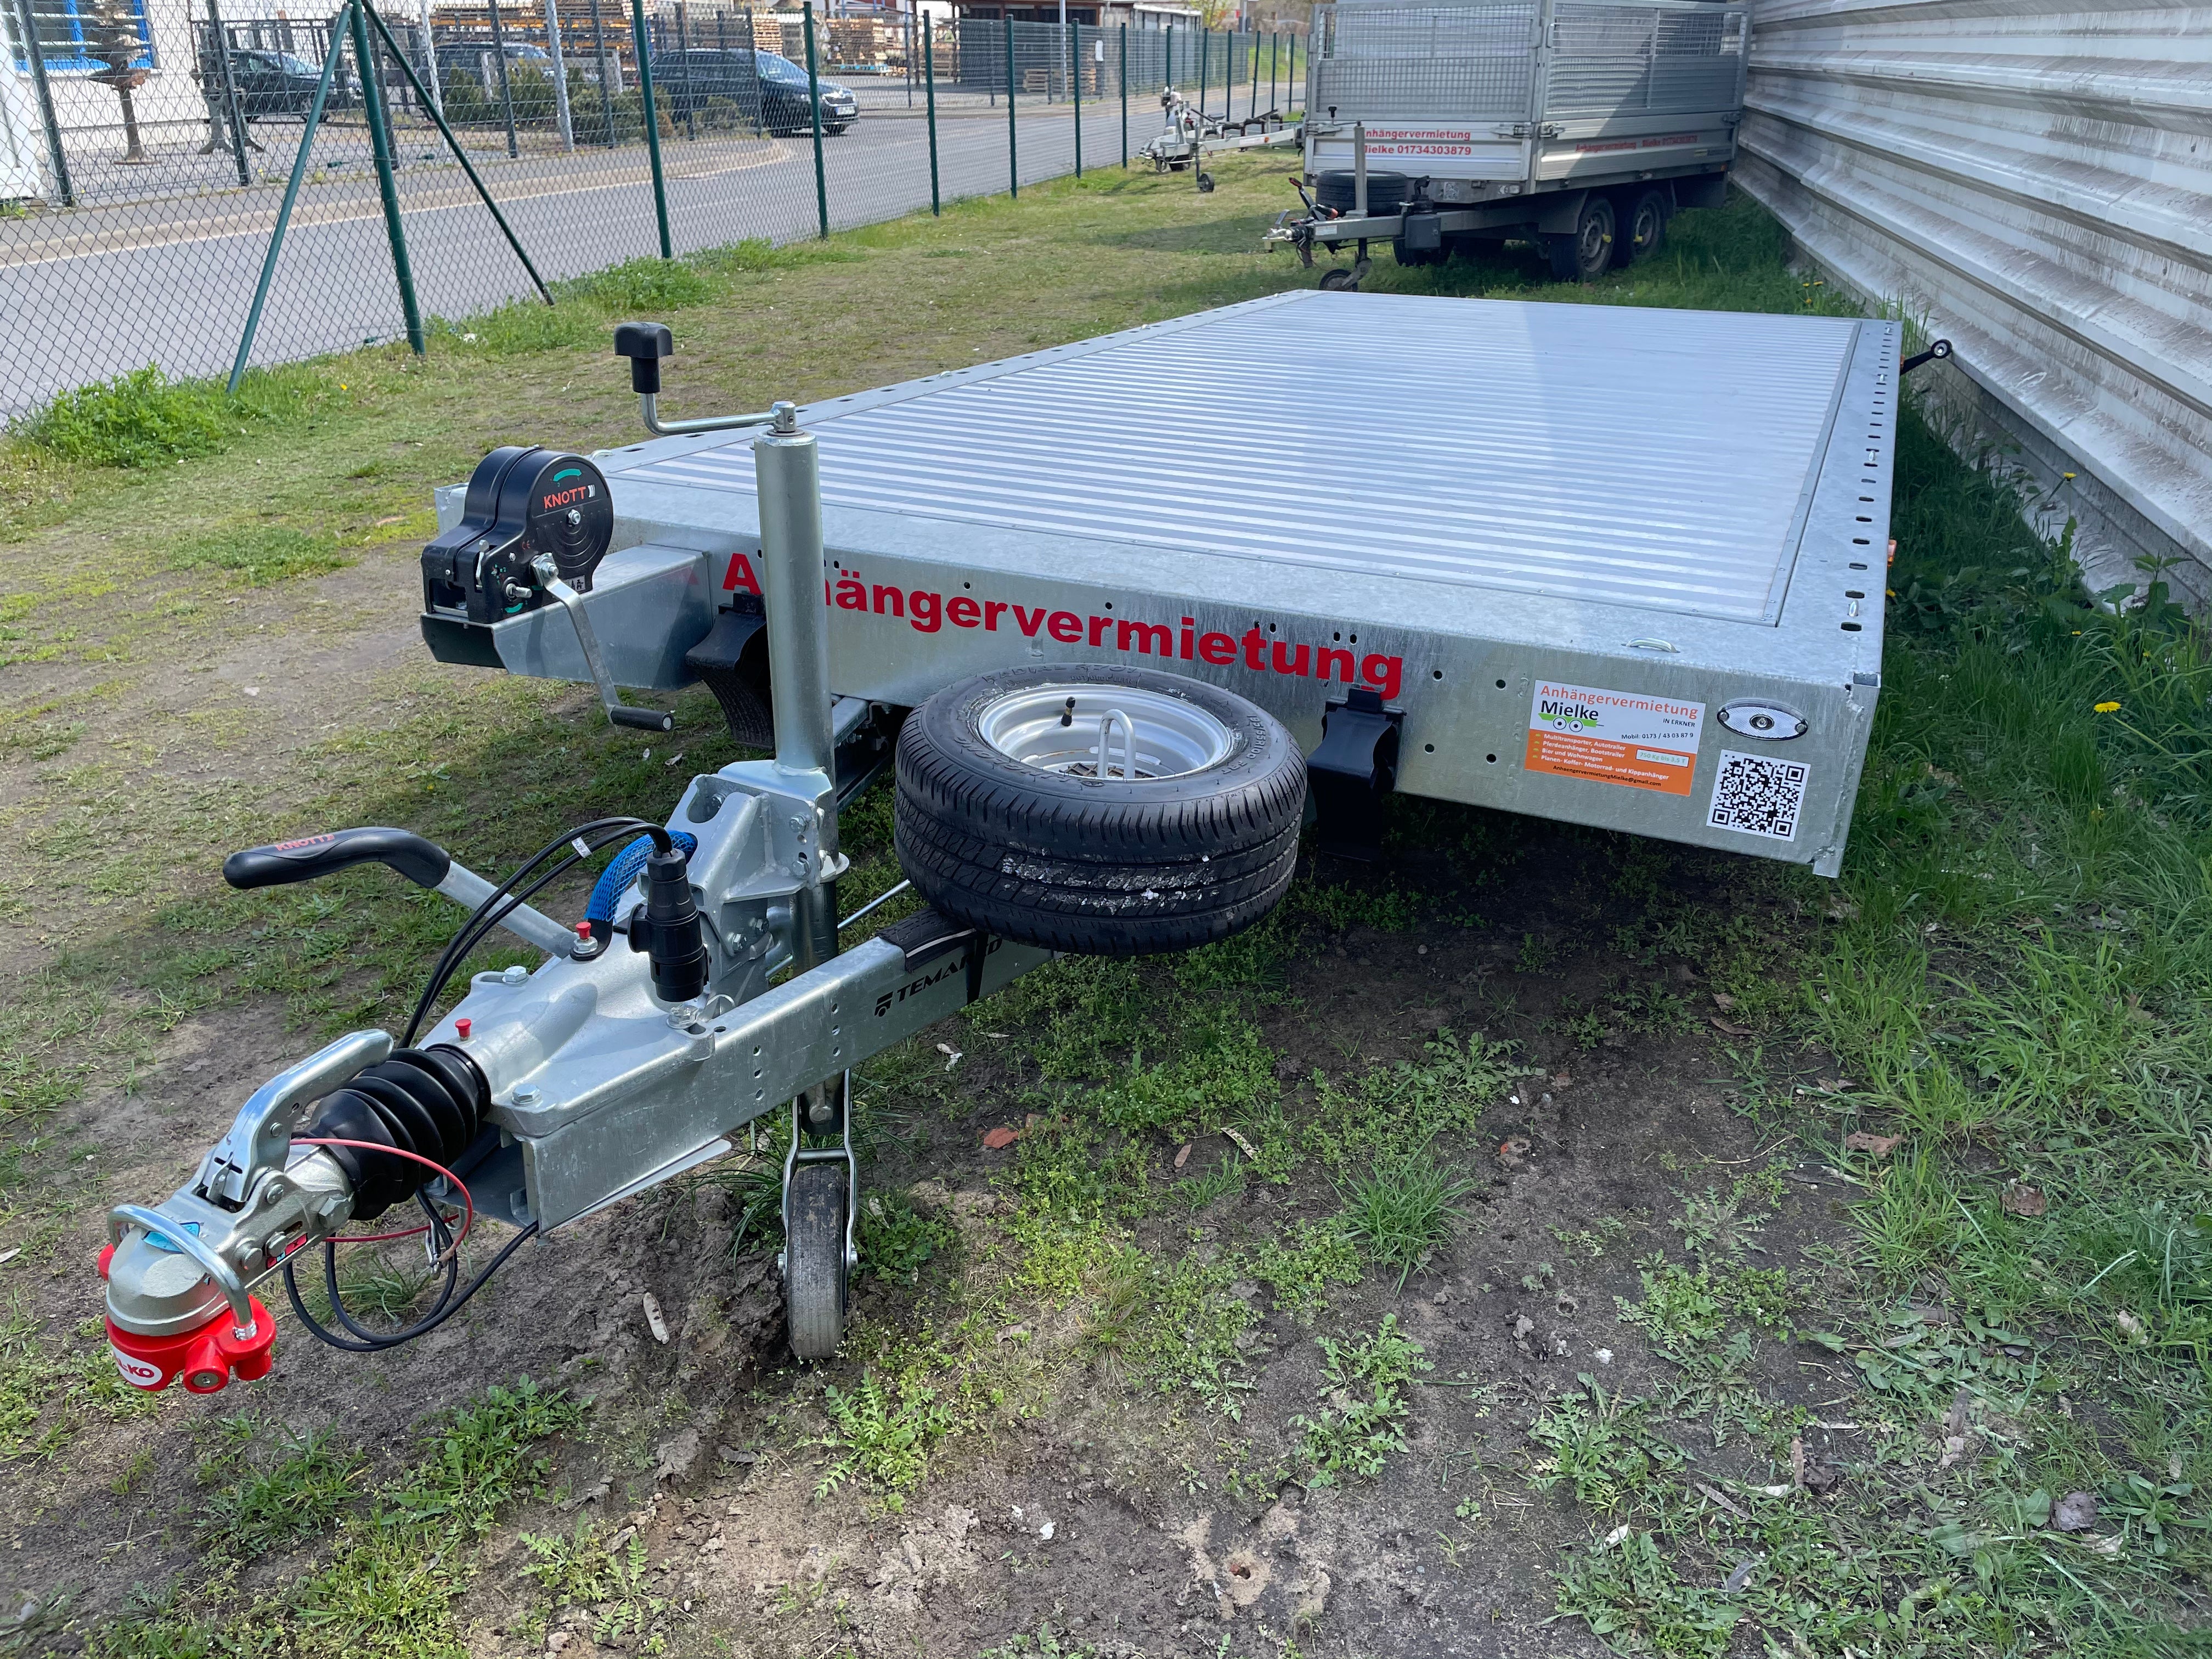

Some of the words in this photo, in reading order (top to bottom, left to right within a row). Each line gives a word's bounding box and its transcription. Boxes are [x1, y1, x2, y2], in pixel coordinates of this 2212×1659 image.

[1366, 129, 1471, 142] nhängervermietung
[1364, 145, 1394, 154] ielke
[1397, 145, 1472, 156] 01734303879
[544, 486, 586, 510] KNOTT
[722, 552, 1403, 701] Aängervermietung
[1541, 685, 1699, 720] Anhängervermietung
[1541, 700, 1599, 720] Mielke
[1672, 719, 1695, 727] ERKNER
[1543, 741, 1589, 754] Pferdeanhänger,
[1590, 748, 1626, 758] Bootstrailer
[1544, 733, 1593, 747] Multitransporter,
[1594, 742, 1627, 751] Autotrailer
[1567, 752, 1603, 762] Wohnwagen
[1584, 761, 1615, 771] Motorrad-
[1628, 768, 1669, 780] Kippanhänger
[275, 836, 325, 851] KNOTT
